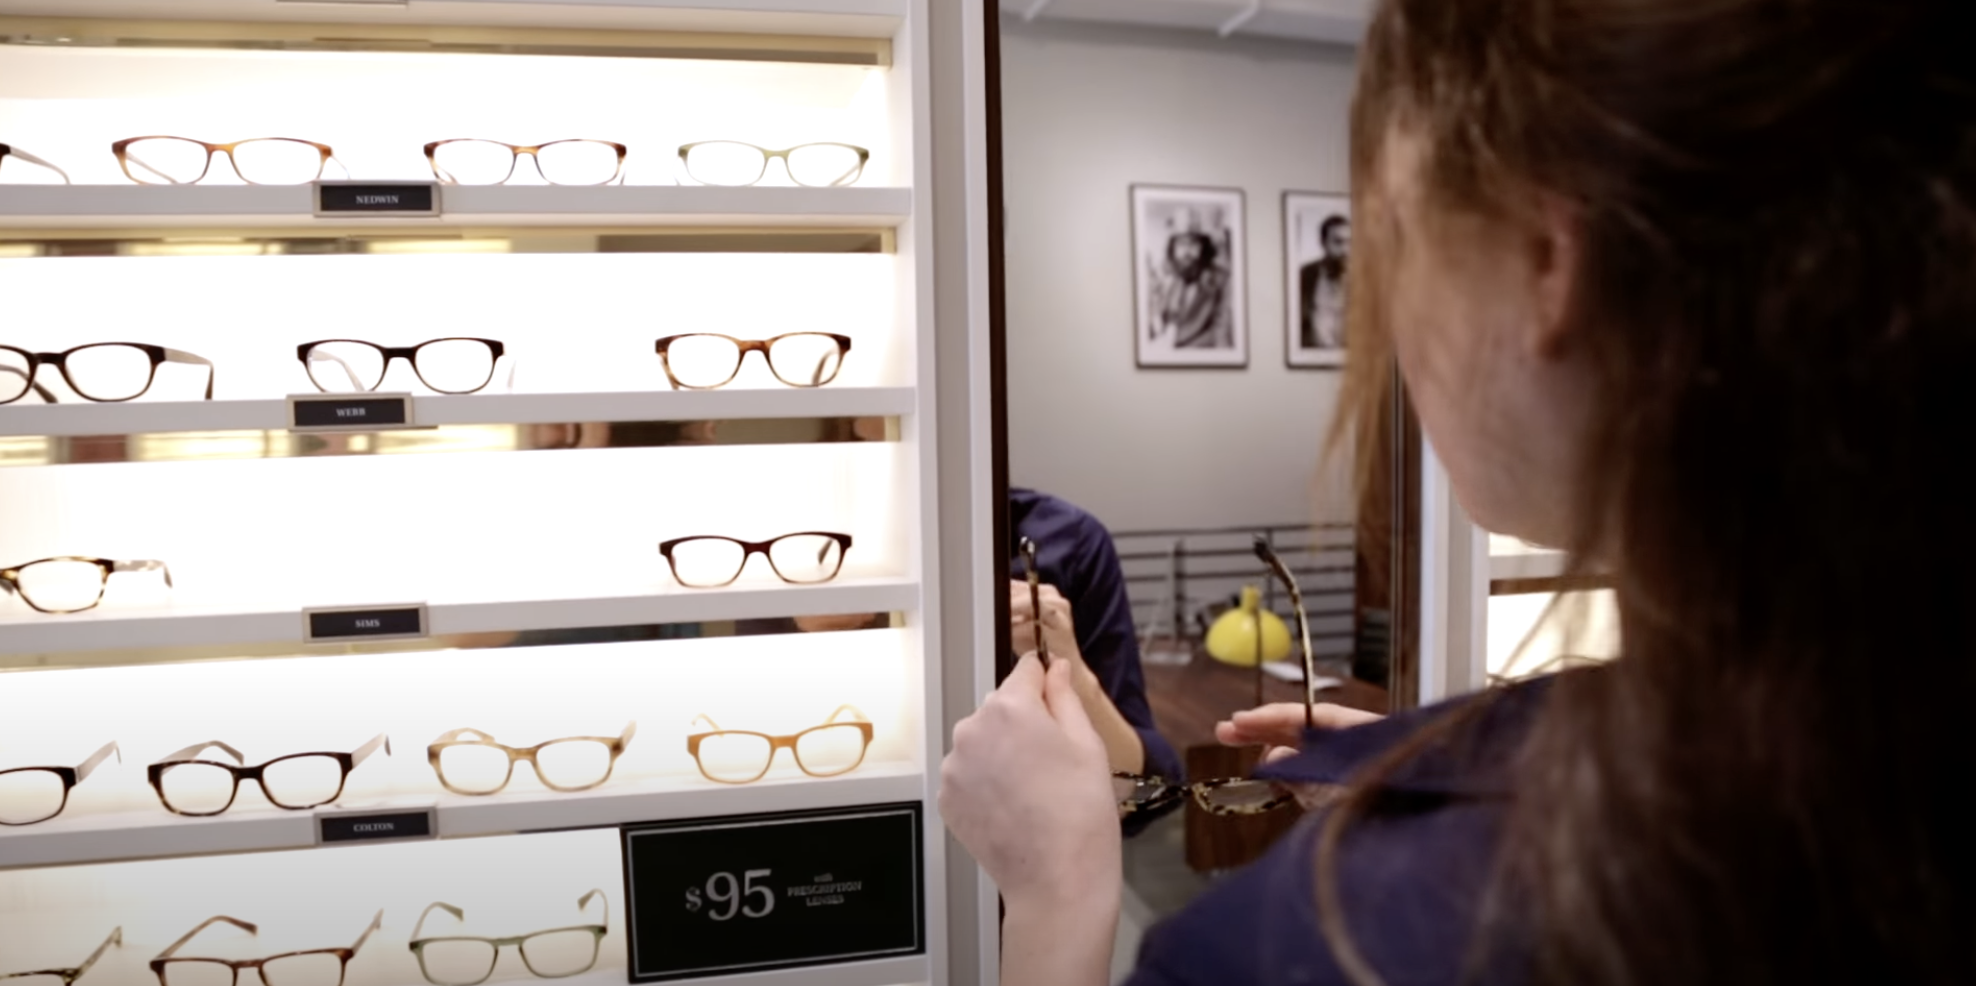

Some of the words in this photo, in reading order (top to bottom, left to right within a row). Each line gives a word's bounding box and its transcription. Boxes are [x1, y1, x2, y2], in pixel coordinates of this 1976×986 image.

[355, 194, 399, 205] NEDWIN
[336, 407, 366, 417] WEBB
[355, 618, 380, 628] SIMS
[353, 822, 394, 832] COLTON
[787, 880, 862, 897] PRESCRIPTION
[685, 868, 775, 921] $95
[806, 893, 844, 907] LENSES
